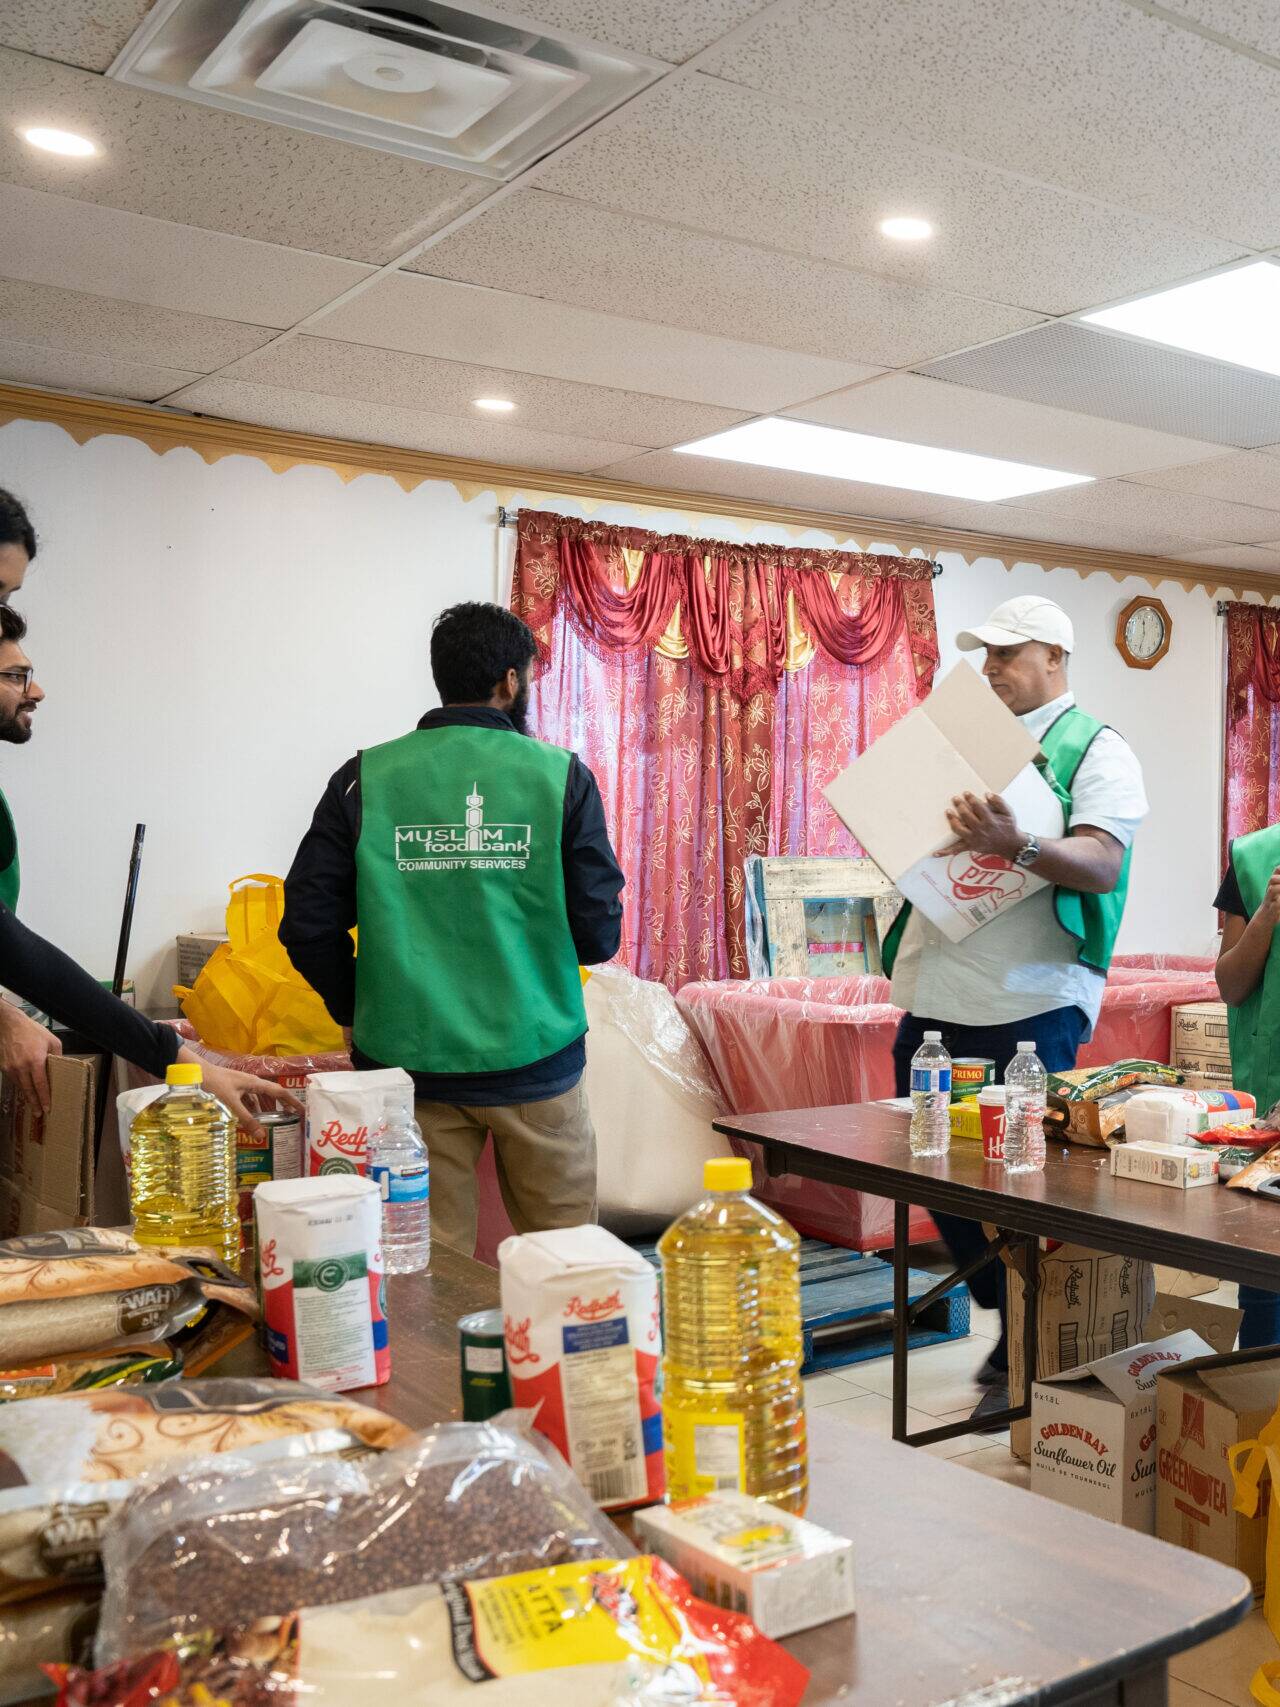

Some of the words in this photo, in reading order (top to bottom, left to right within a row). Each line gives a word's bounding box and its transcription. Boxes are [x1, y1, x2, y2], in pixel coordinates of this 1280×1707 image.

[425, 840, 468, 854] food
[480, 840, 530, 853] bank
[398, 859, 468, 872] COMMUNITY
[470, 858, 527, 870] SERVICES
[958, 865, 1005, 886] PTI
[952, 1068, 983, 1079] PRIMO
[125, 1289, 171, 1309] WAH
[1065, 1264, 1084, 1310] Redpath
[1128, 1352, 1159, 1378] GOLDEN
[1158, 1351, 1183, 1362] RAY
[1040, 1422, 1084, 1441] GOLDEN
[1083, 1428, 1109, 1457] RAY
[1034, 1440, 1095, 1472] Sunflower
[1096, 1459, 1117, 1478] Oil
[1158, 1447, 1193, 1497] GREEN
[1208, 1473, 1228, 1516] TEA
